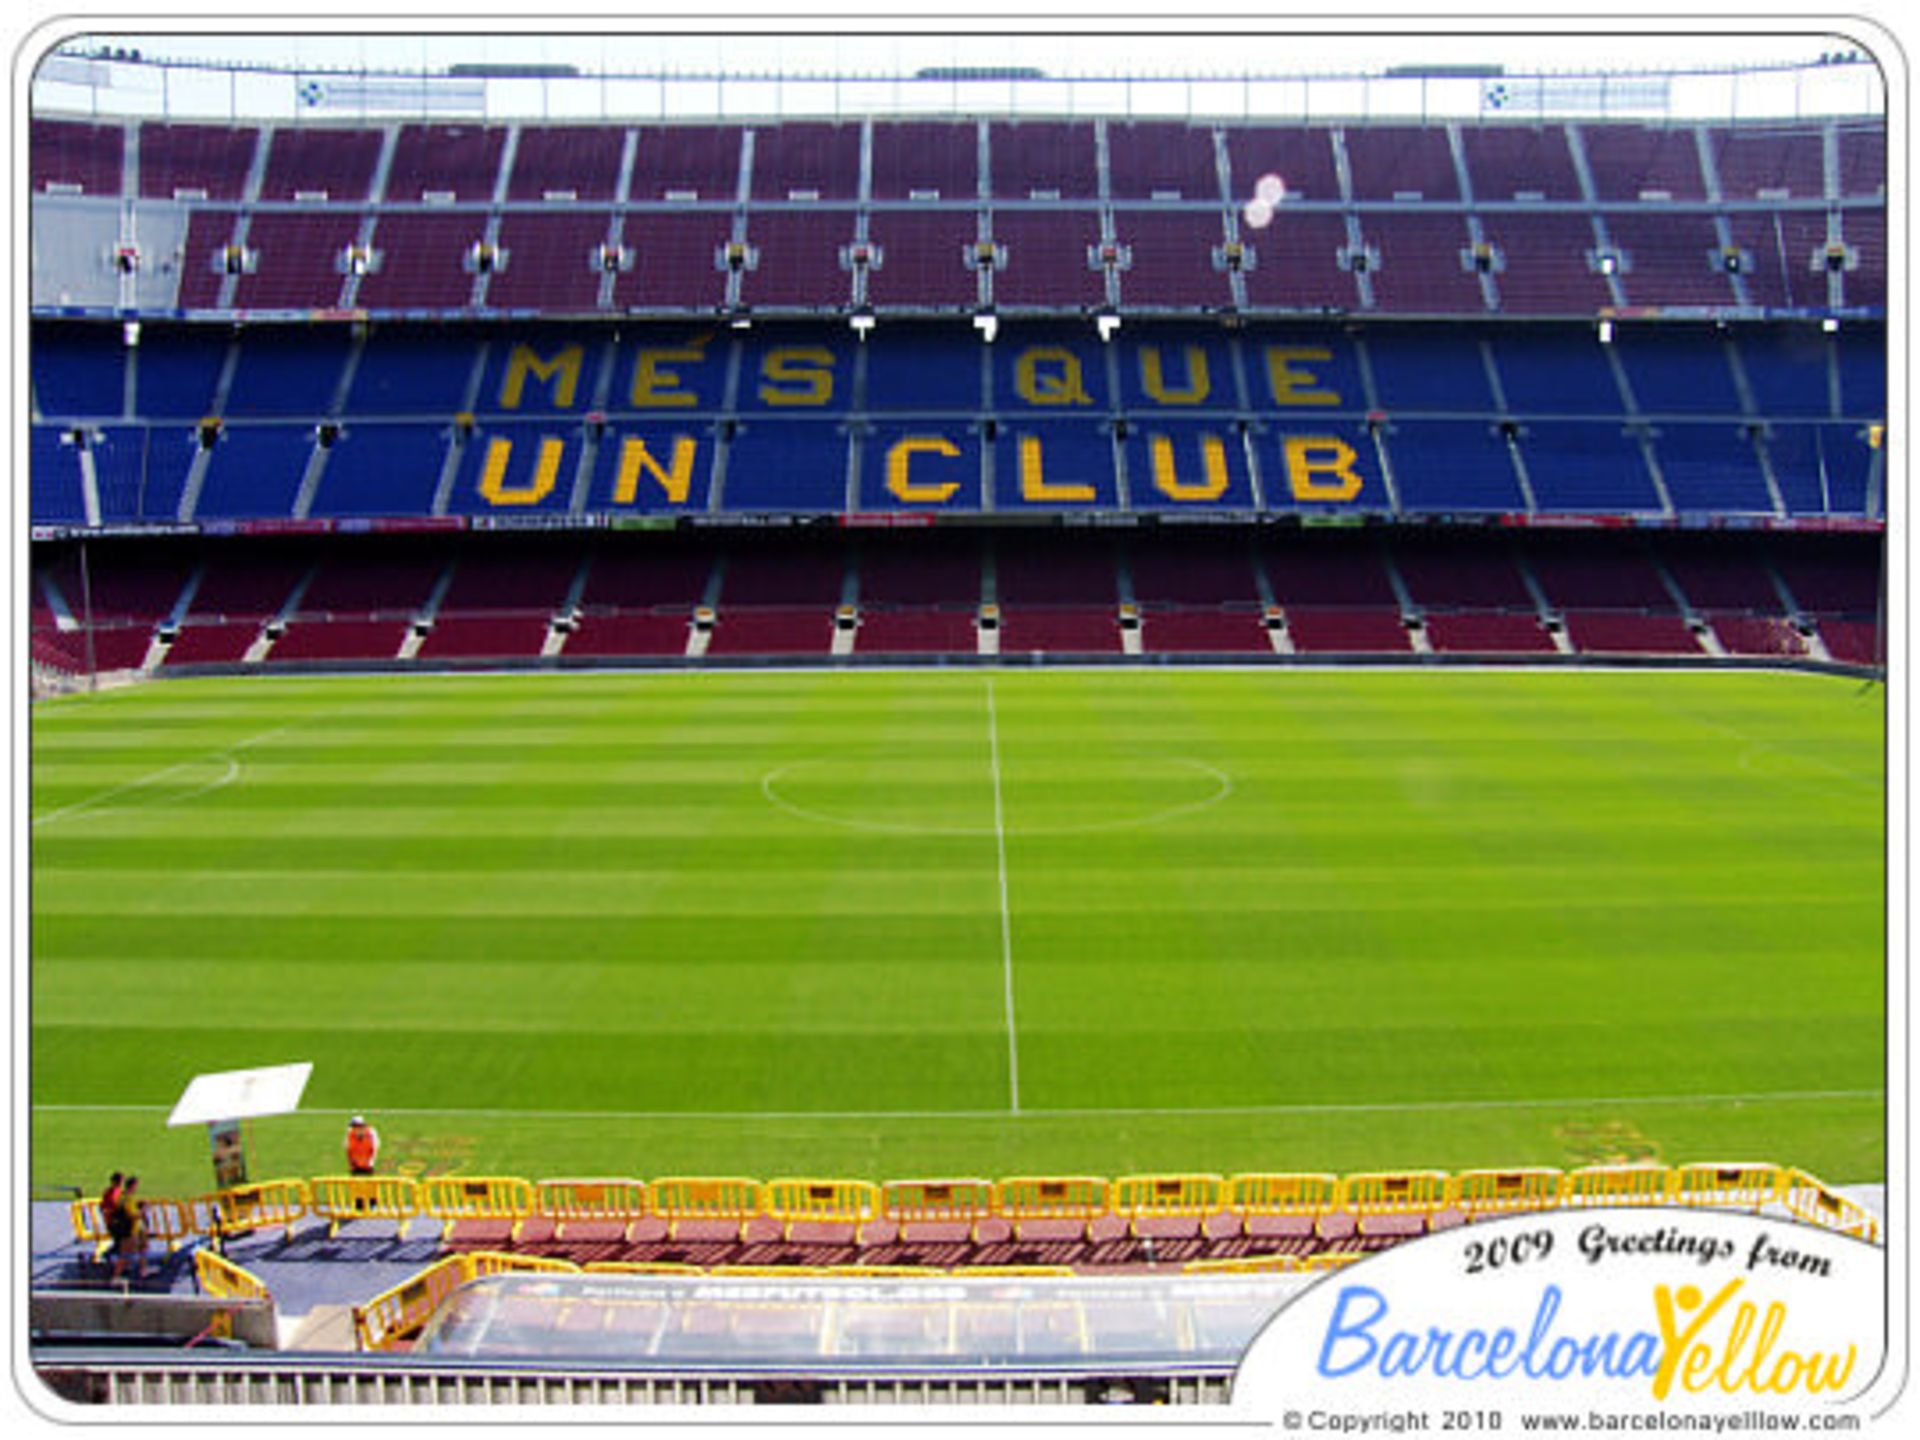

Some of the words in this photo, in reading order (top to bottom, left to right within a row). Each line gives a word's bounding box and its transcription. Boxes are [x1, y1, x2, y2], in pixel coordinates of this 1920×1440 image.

[502, 334, 836, 407] MÉS
[1016, 348, 1343, 405] QUE
[480, 436, 697, 506] UN
[886, 437, 1365, 504] CLUB
